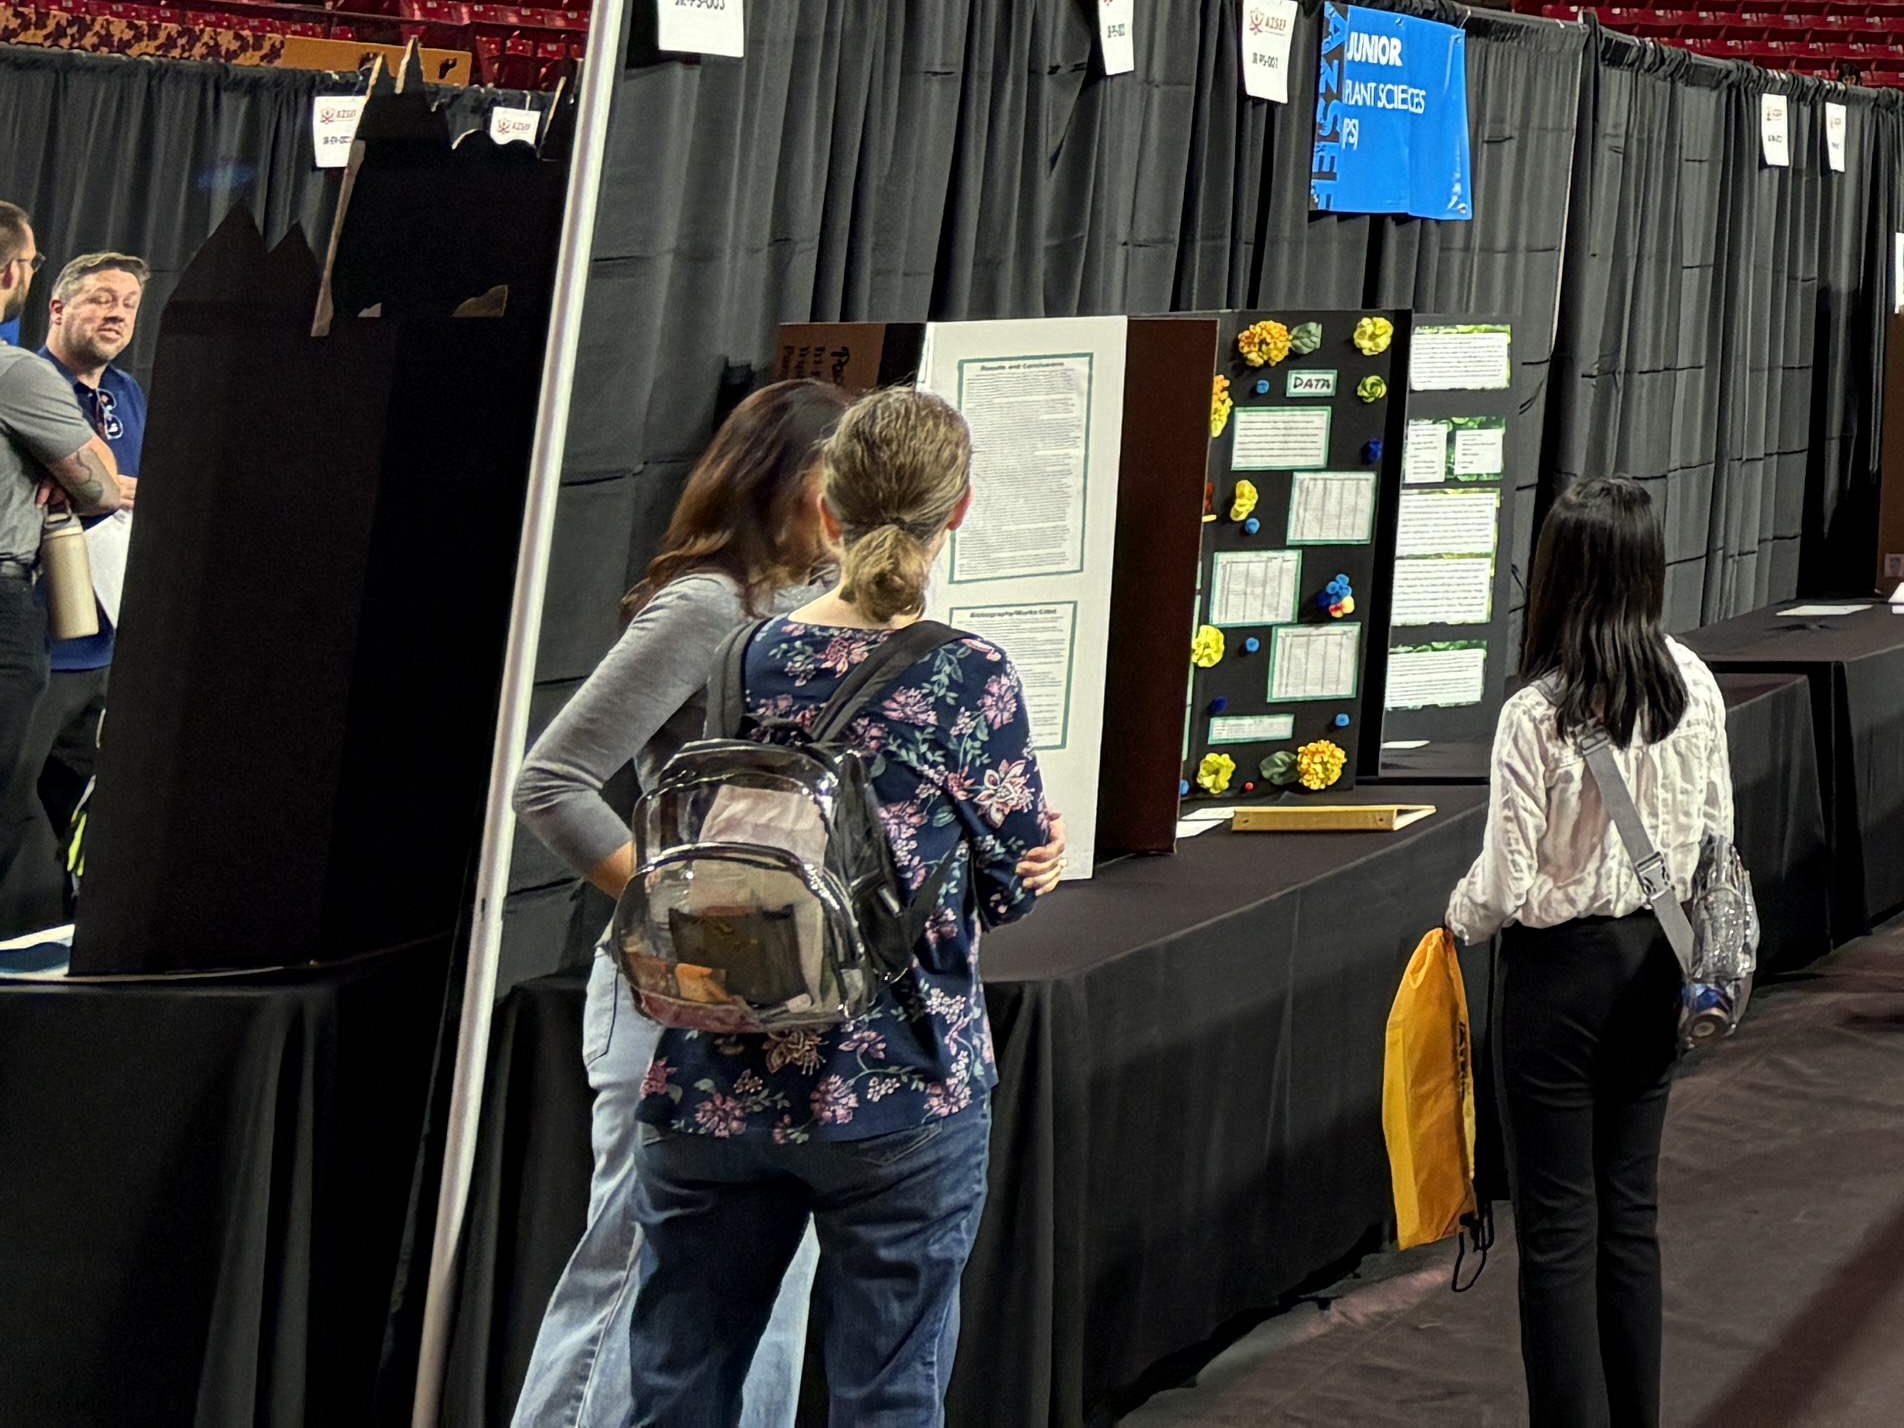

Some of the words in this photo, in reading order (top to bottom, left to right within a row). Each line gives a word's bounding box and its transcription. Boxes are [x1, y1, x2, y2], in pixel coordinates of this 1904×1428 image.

[1265, 15, 1287, 31] AZSEF
[1346, 30, 1402, 67] JUNIOR
[1378, 81, 1426, 114] SCIECES
[1293, 376, 1331, 390] DATA
